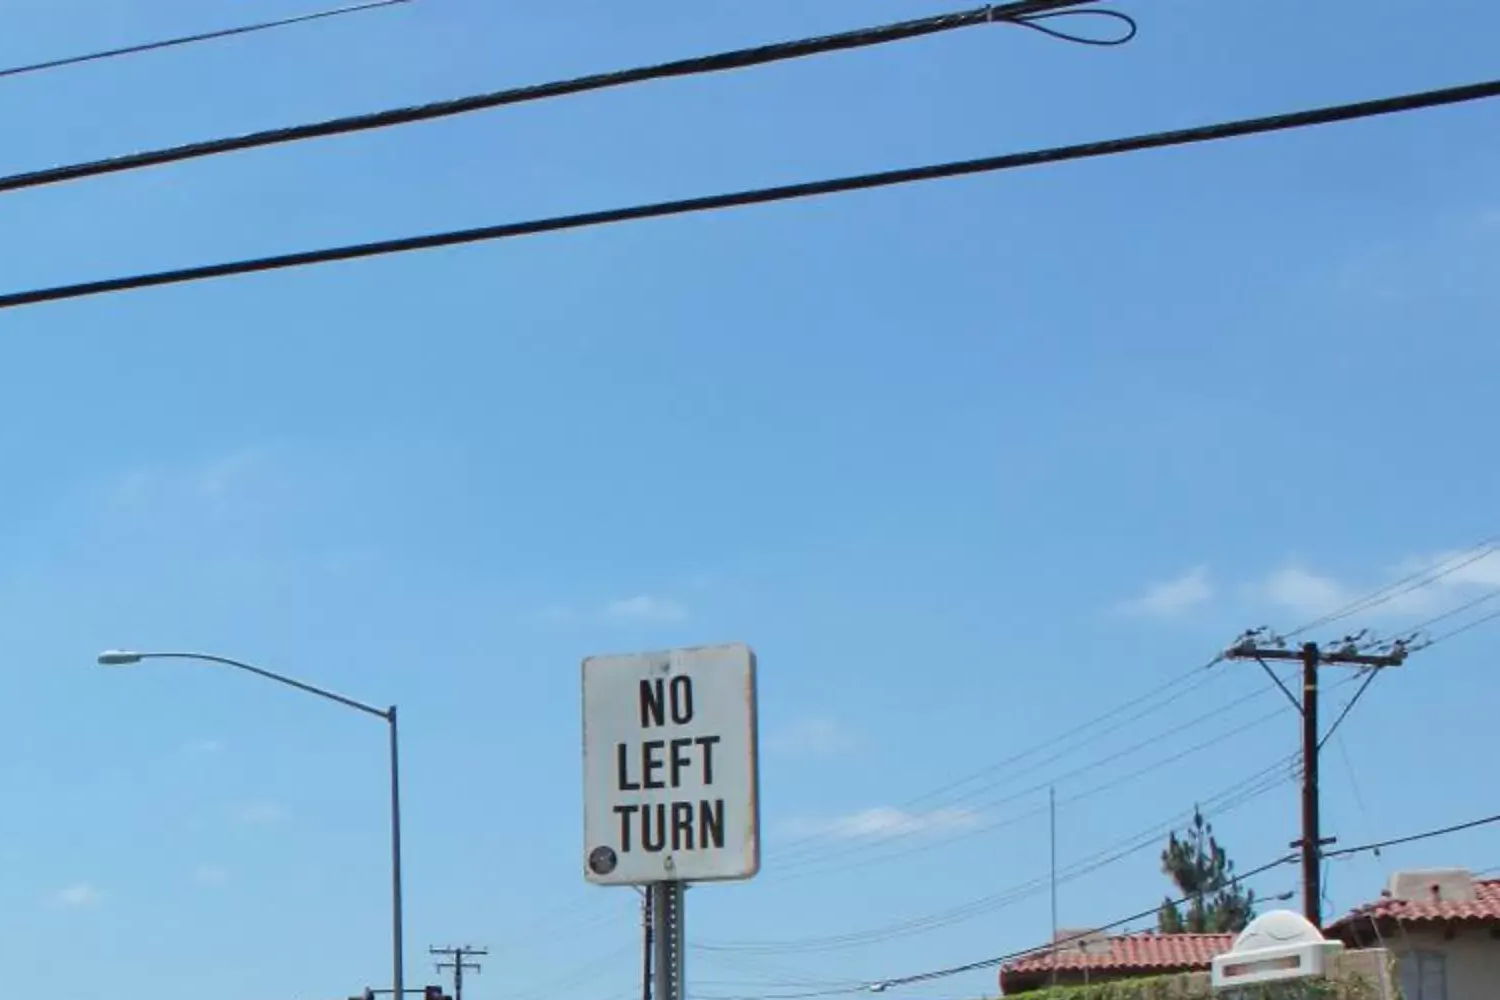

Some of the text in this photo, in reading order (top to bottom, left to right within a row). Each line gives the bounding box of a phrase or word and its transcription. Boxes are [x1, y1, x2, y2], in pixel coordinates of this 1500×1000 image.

[640, 675, 694, 728] NO
[617, 735, 720, 790] LEFT
[613, 799, 724, 852] TURN
